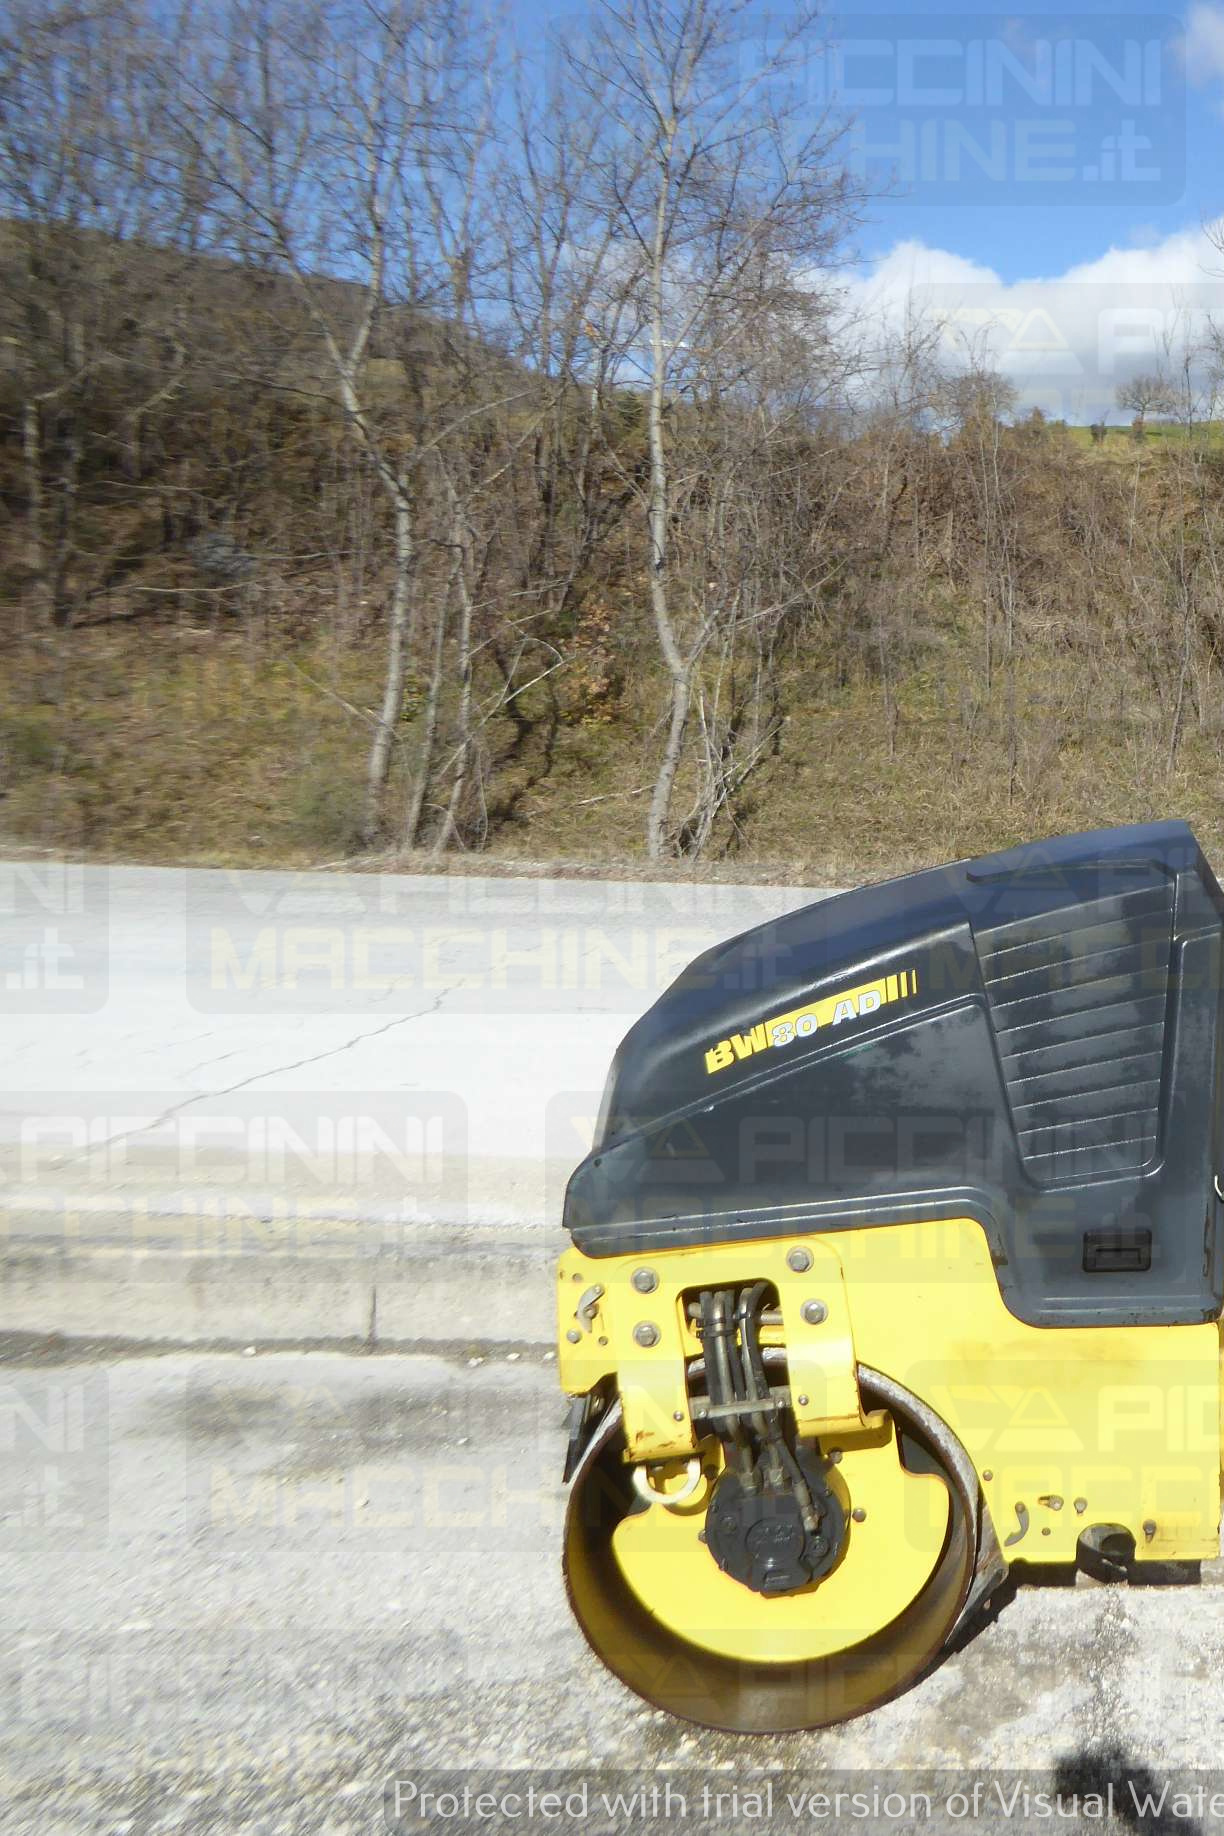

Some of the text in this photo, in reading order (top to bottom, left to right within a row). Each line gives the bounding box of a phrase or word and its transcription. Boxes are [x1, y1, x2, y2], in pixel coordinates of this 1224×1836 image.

[705, 989, 882, 1074] BW 80 AD
